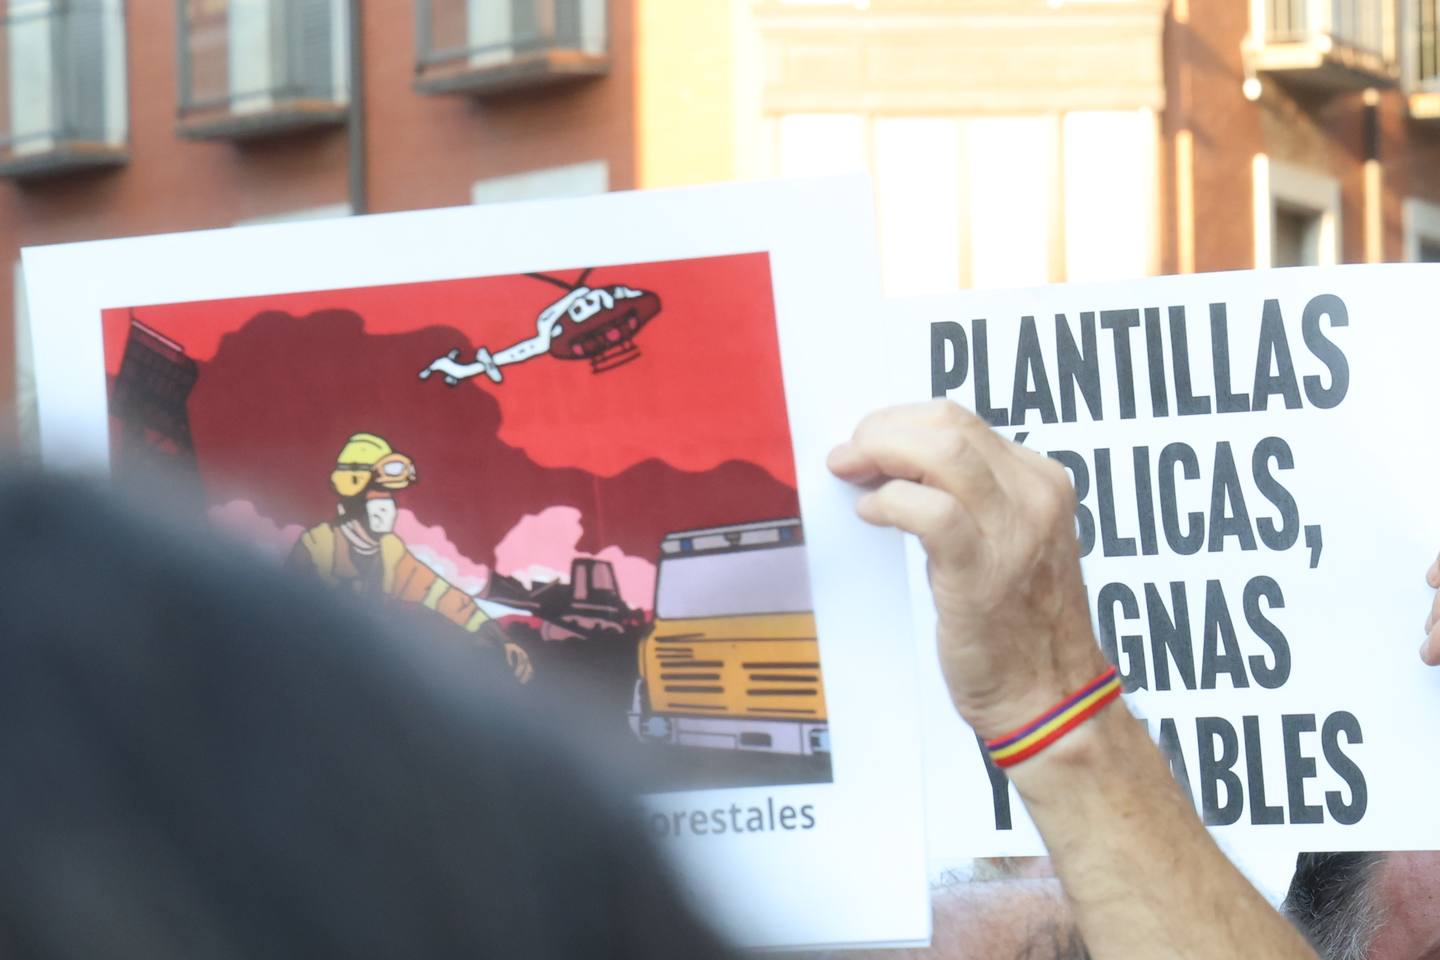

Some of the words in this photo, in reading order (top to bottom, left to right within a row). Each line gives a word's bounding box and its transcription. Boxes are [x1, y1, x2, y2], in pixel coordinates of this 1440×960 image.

[930, 293, 1350, 428] PLANTILLAS
[1010, 432, 1323, 569] BLICAS,
[1092, 575, 1292, 693] GNAS
[651, 795, 816, 838] orestales
[1140, 710, 1368, 827] ABLES
